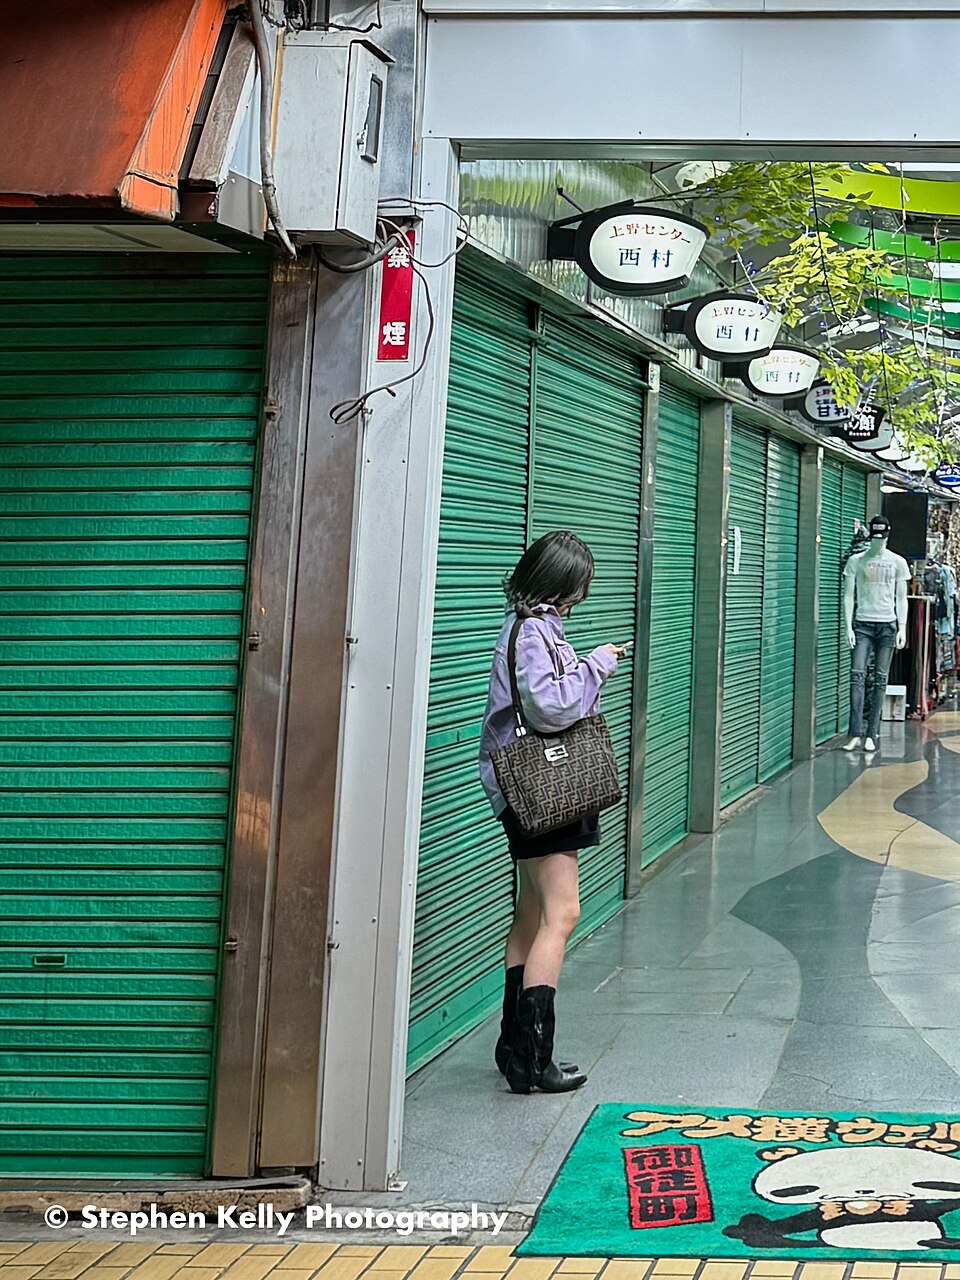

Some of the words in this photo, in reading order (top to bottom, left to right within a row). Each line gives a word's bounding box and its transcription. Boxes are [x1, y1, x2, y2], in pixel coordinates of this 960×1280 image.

[608, 223, 691, 244] 上野センター
[618, 247, 674, 268] 西村
[382, 246, 410, 346] 禁煙
[712, 306, 775, 323] 上野センター
[717, 324, 760, 341] 西村
[630, 1147, 700, 1221] 御徒町
